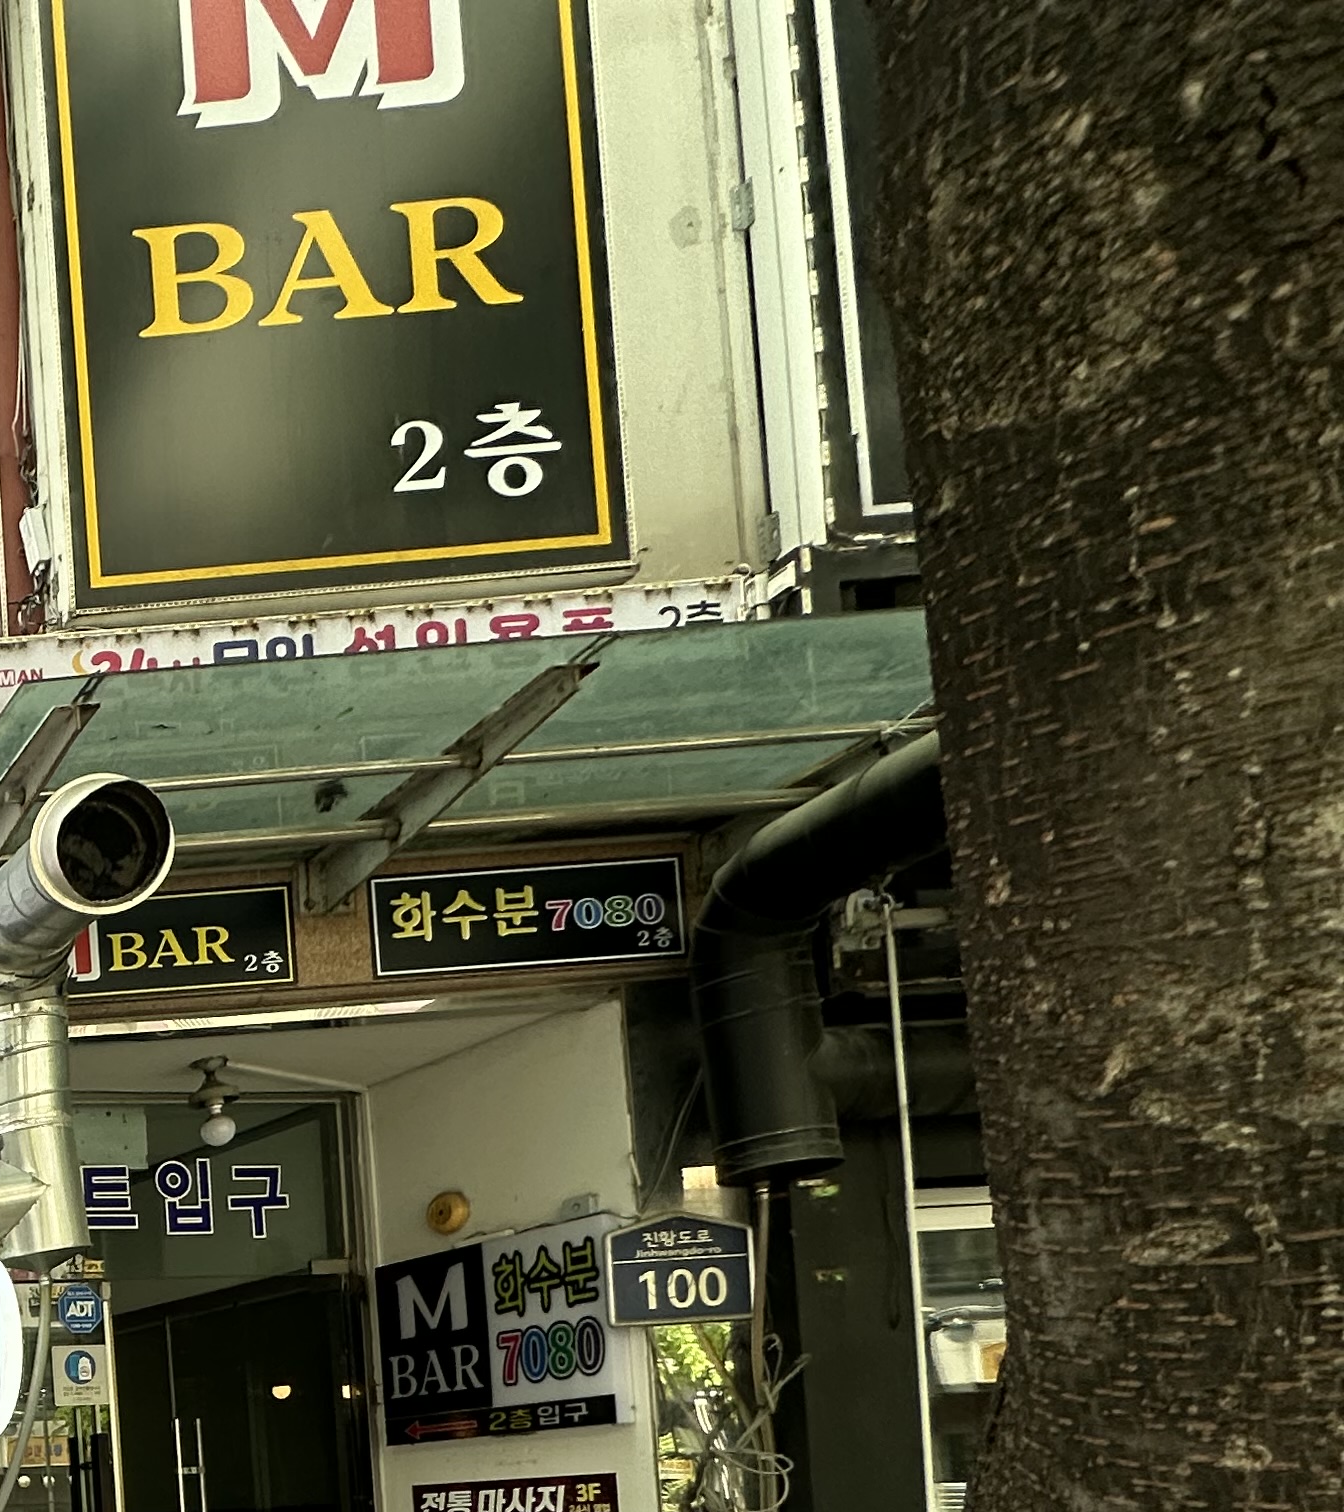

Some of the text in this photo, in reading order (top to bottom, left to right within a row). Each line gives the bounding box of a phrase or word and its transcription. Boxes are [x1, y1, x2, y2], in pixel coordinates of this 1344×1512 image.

[132, 196, 525, 339] BAR
[389, 401, 562, 498] 2층
[389, 884, 665, 942] 화수분 7080
[636, 926, 673, 948] 2층
[107, 925, 235, 972] BAR
[244, 950, 284, 974] 2층
[642, 1229, 714, 1248] 진황도로
[395, 1261, 469, 1340] M
[492, 1236, 599, 1318] 화수분
[638, 1266, 728, 1310] 100
[65, 1300, 95, 1317] ADT
[388, 1344, 485, 1400] BAR
[496, 1316, 606, 1387] 7080
[489, 1402, 589, 1432] 2층 입구
[575, 1483, 602, 1502] 3F
